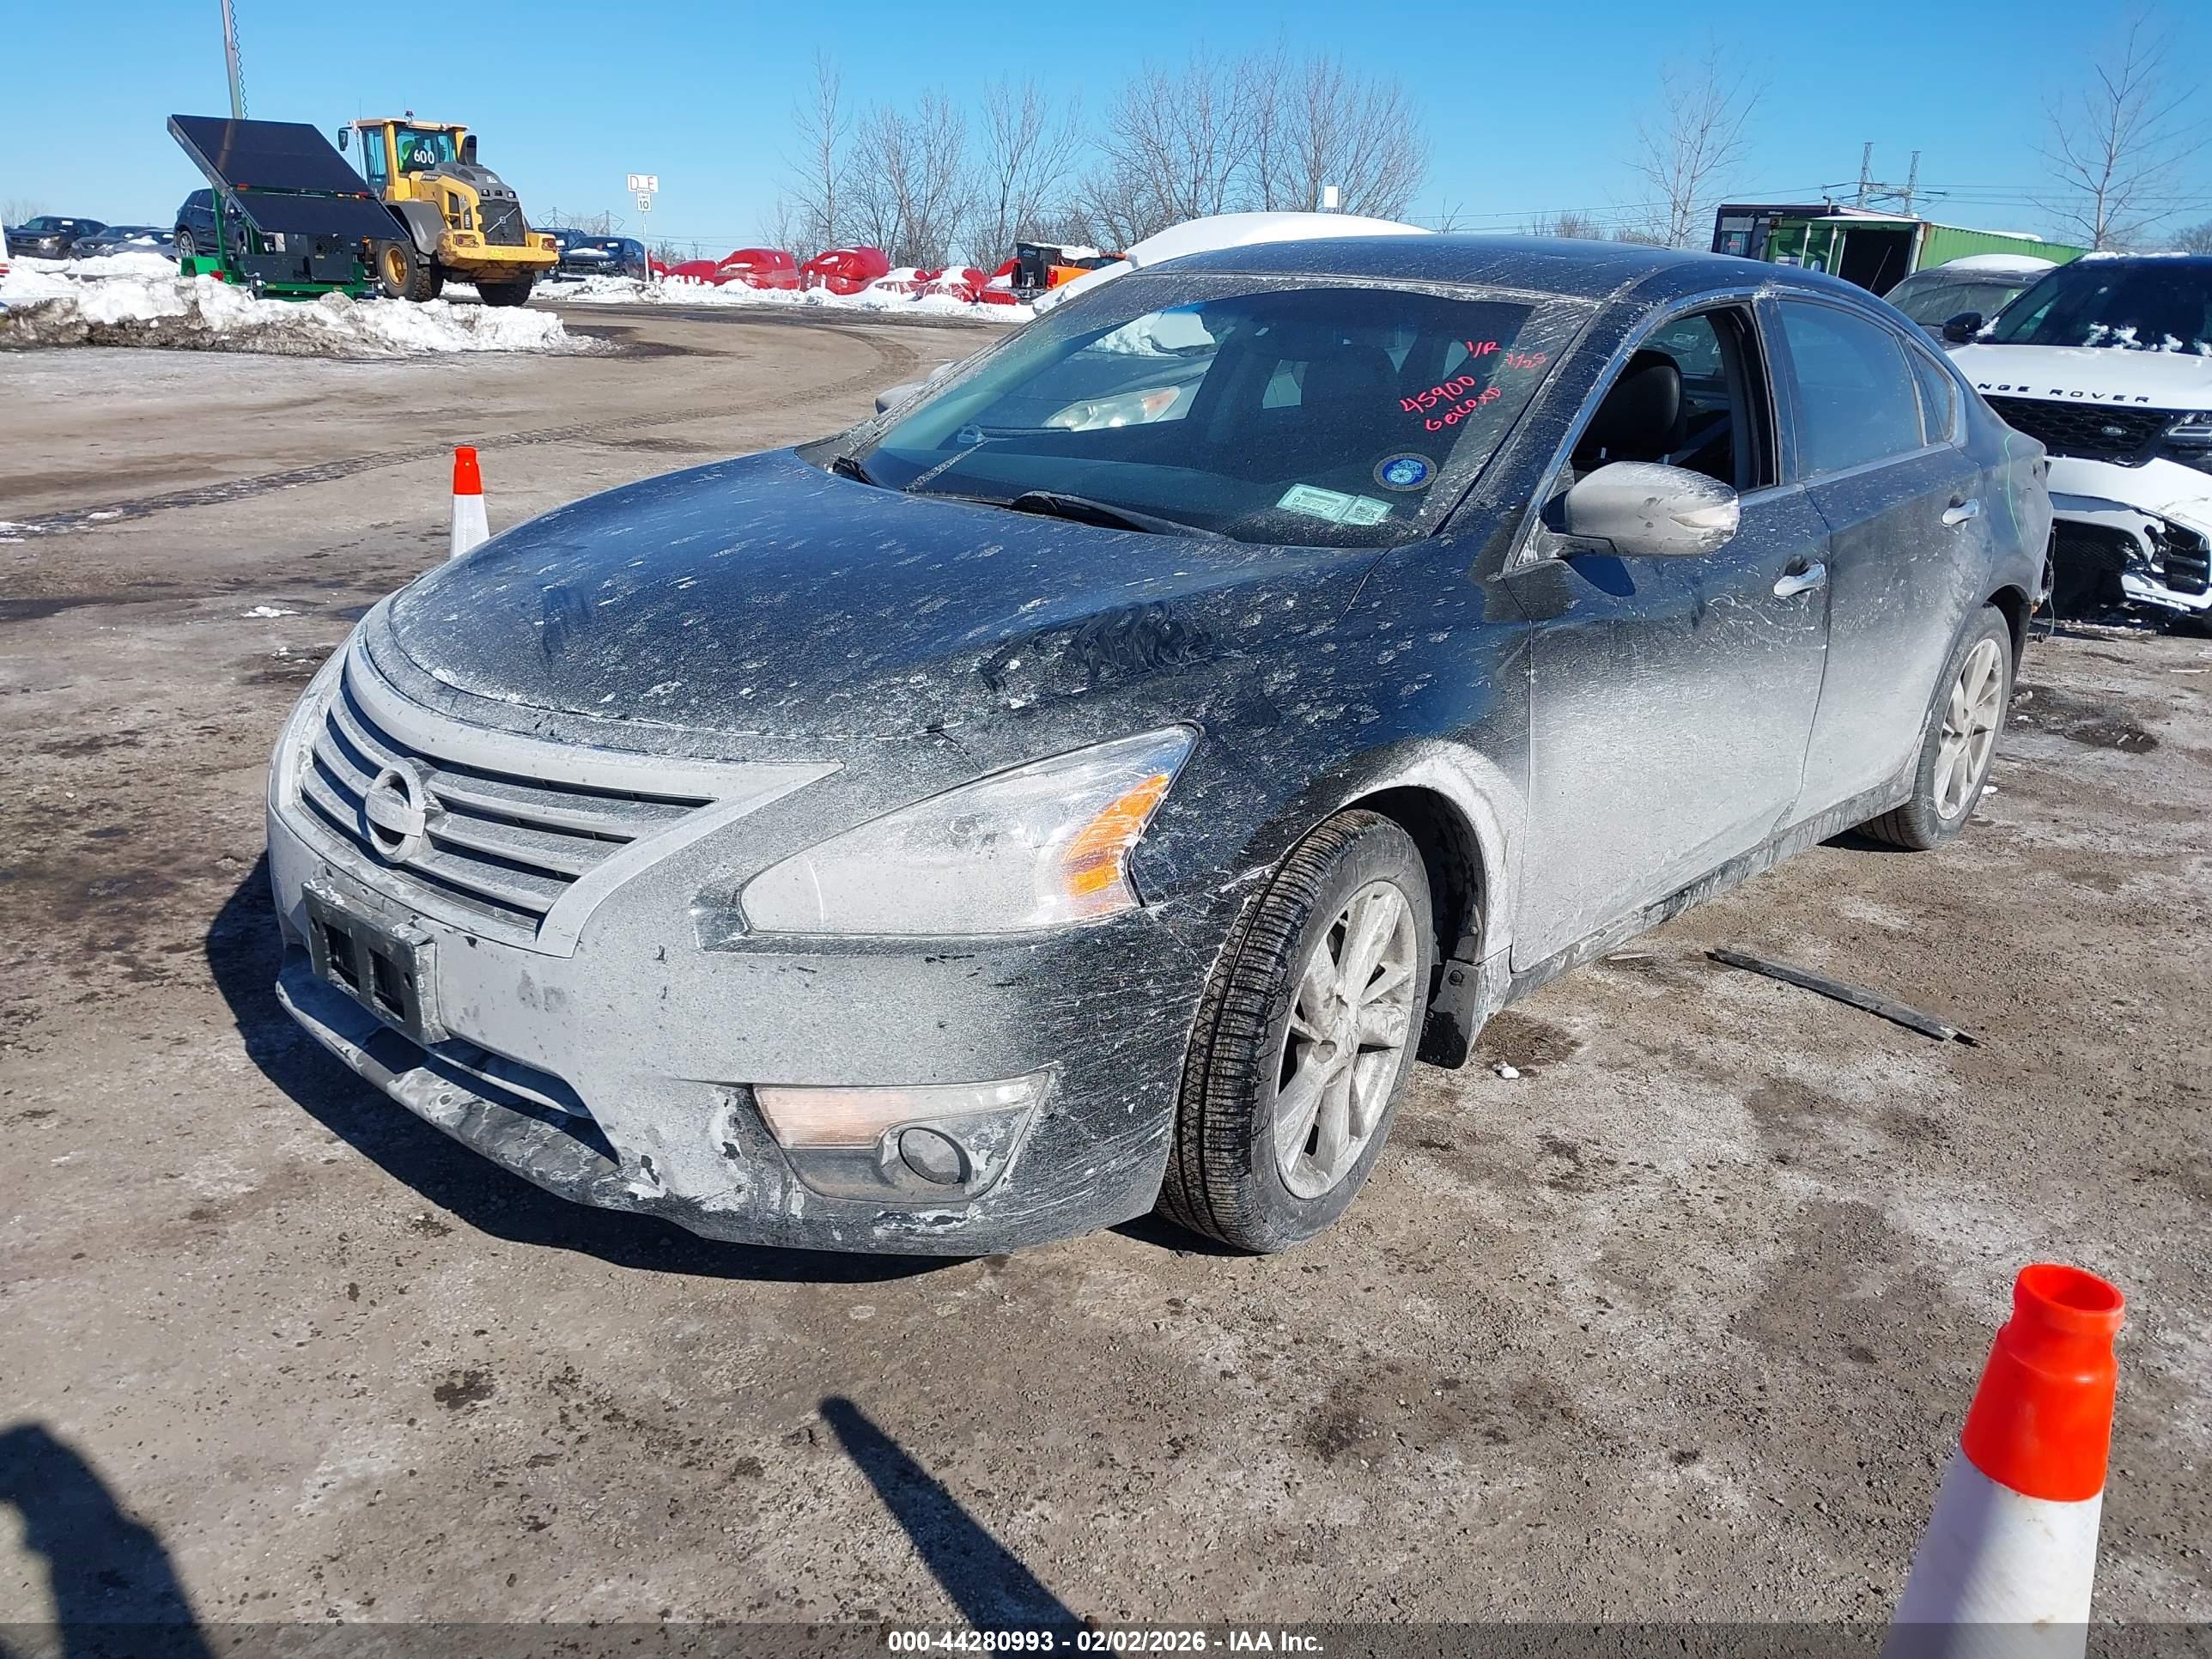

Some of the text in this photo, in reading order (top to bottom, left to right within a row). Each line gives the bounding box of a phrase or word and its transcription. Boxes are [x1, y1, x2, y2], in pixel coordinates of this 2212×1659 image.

[413, 149, 434, 164] 600
[639, 200, 649, 210] 10
[1978, 383, 2149, 403] NGE ROVER
